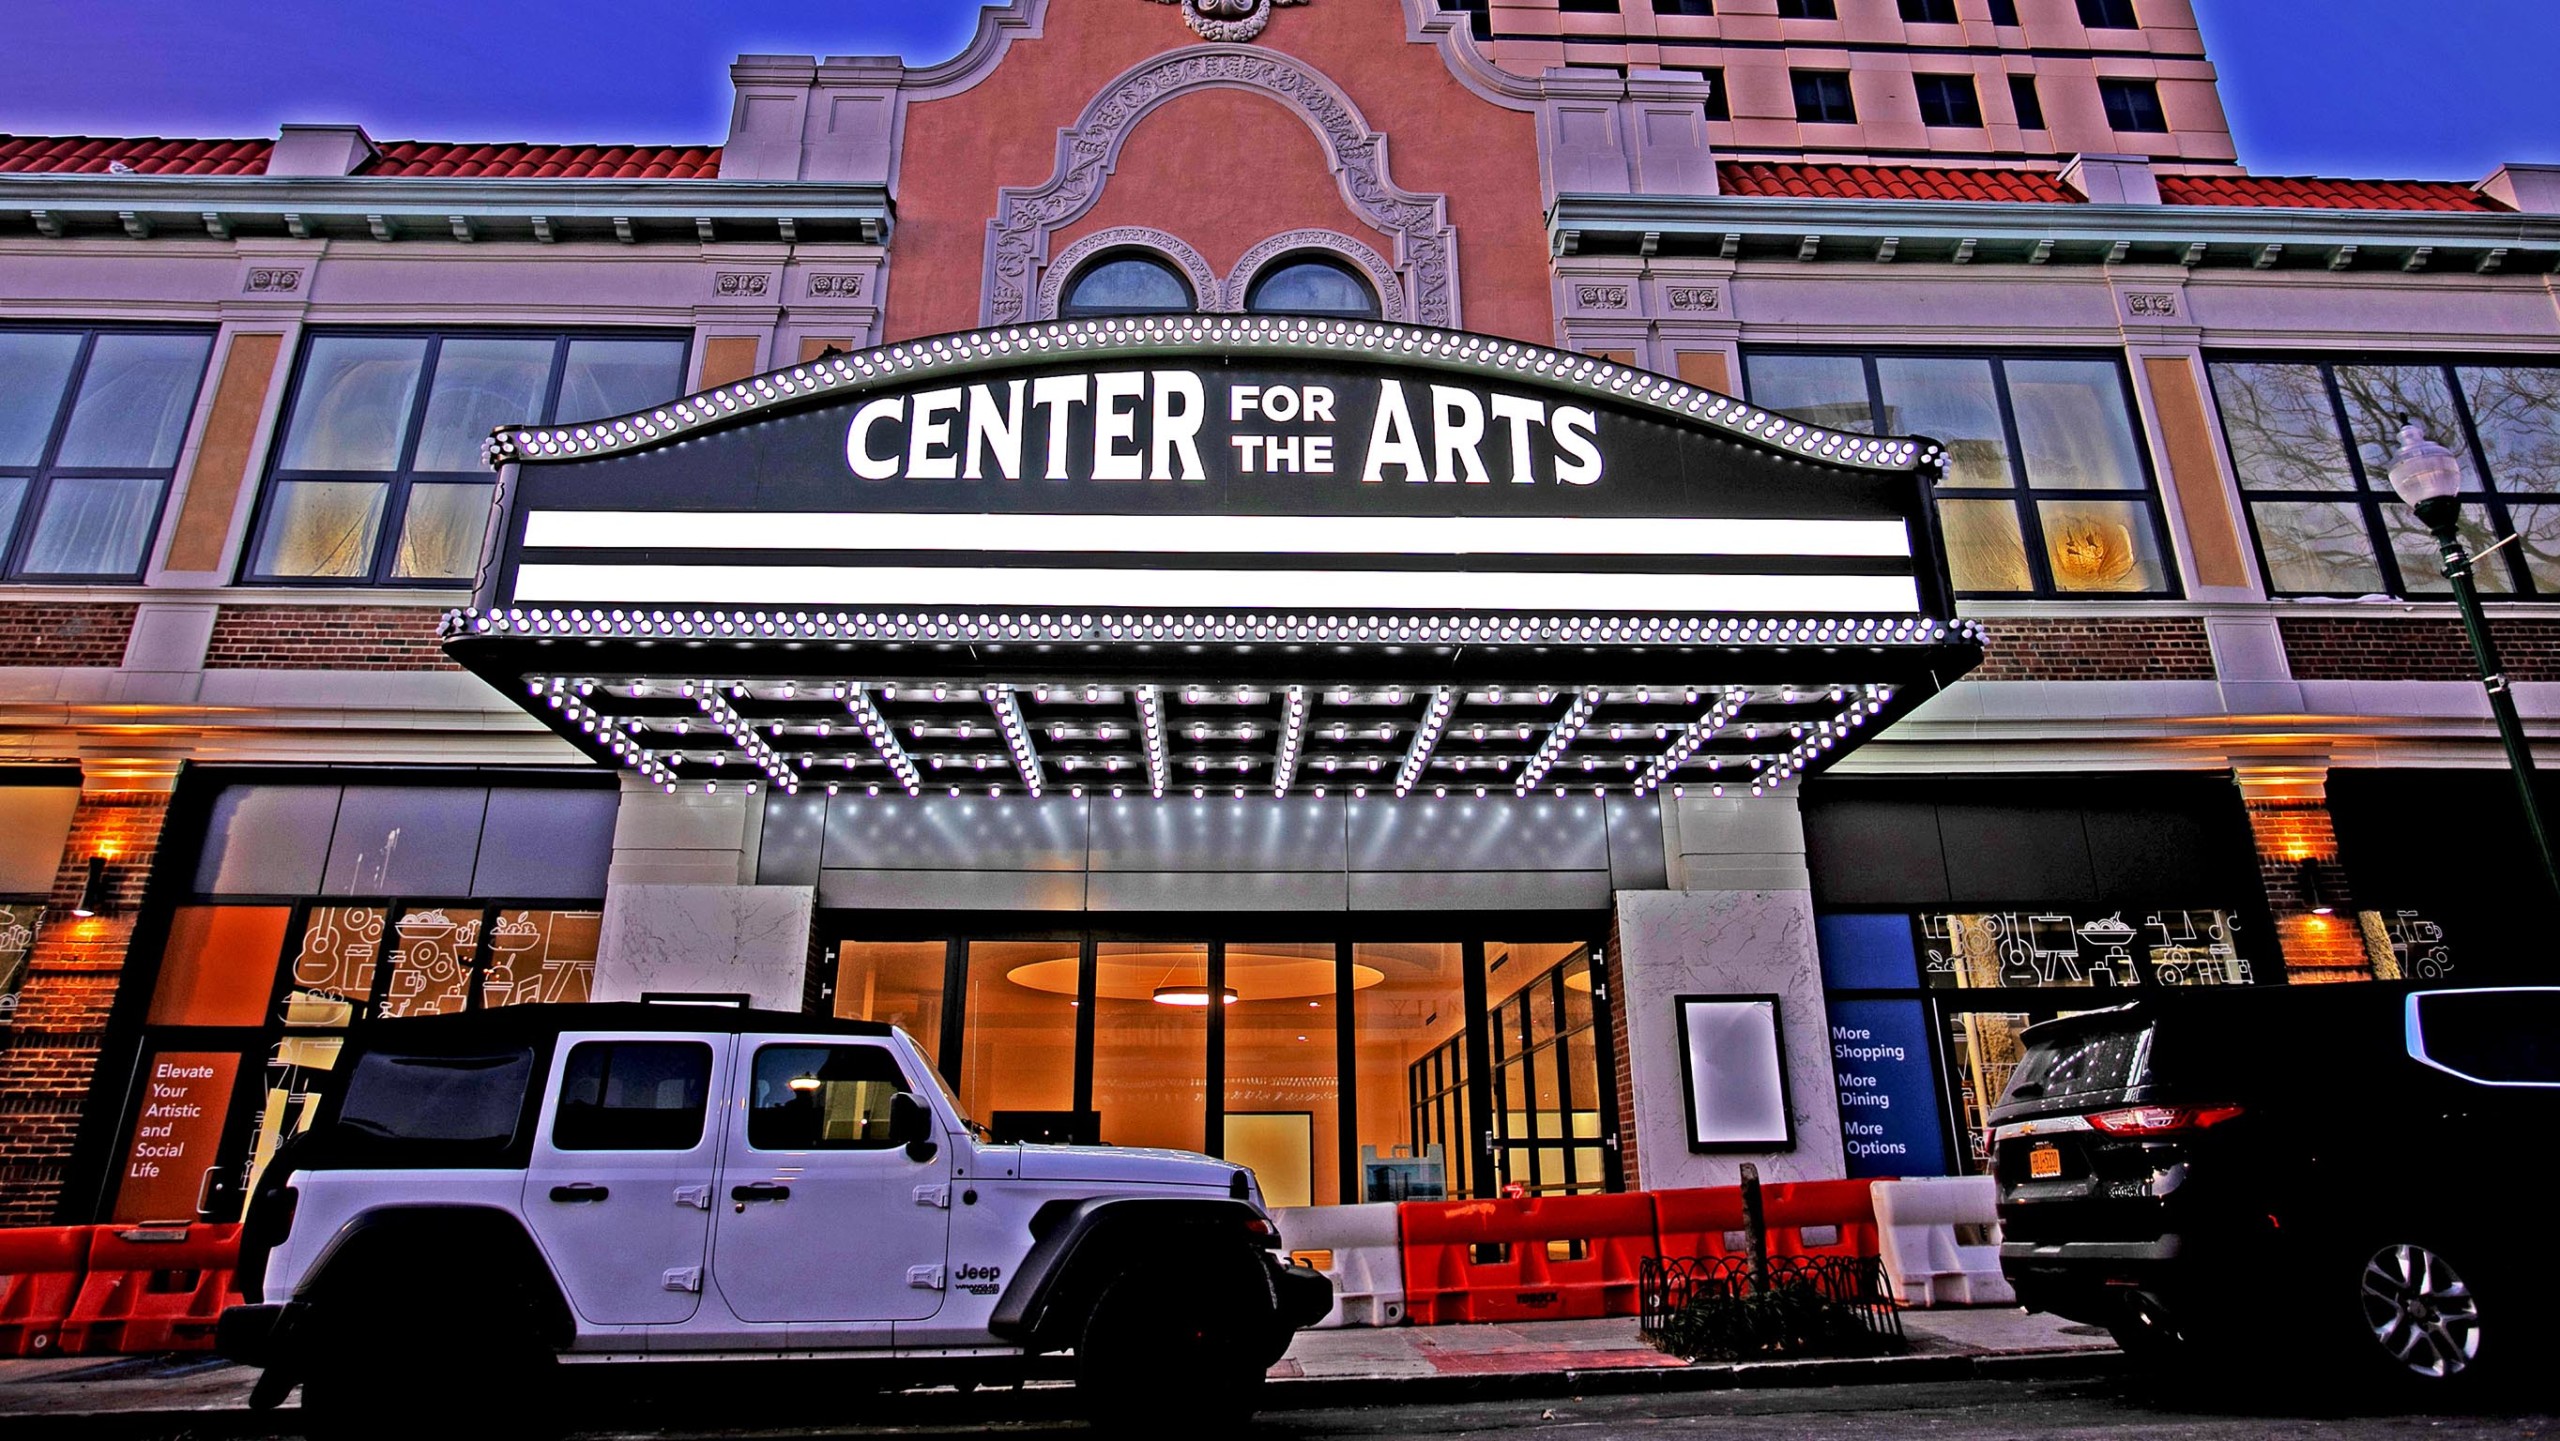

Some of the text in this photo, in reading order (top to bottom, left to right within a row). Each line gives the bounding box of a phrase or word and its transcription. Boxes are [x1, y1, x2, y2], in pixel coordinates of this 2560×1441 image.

[846, 370, 1604, 485] CENTER FOR THE ARTS
[1833, 1027, 1870, 1039] More
[1836, 1044, 1904, 1061] Shopping
[157, 1064, 213, 1077] Elevate
[1839, 1074, 1876, 1086] More
[154, 1084, 187, 1097] Your
[1842, 1092, 1889, 1109] Dining
[146, 1104, 200, 1117] Artistic
[141, 1123, 172, 1136] and
[1845, 1122, 1883, 1134] More
[136, 1143, 184, 1156] Social
[1848, 1141, 1906, 1157] Options
[131, 1162, 159, 1176] Life
[955, 1263, 1000, 1281] Jeep
